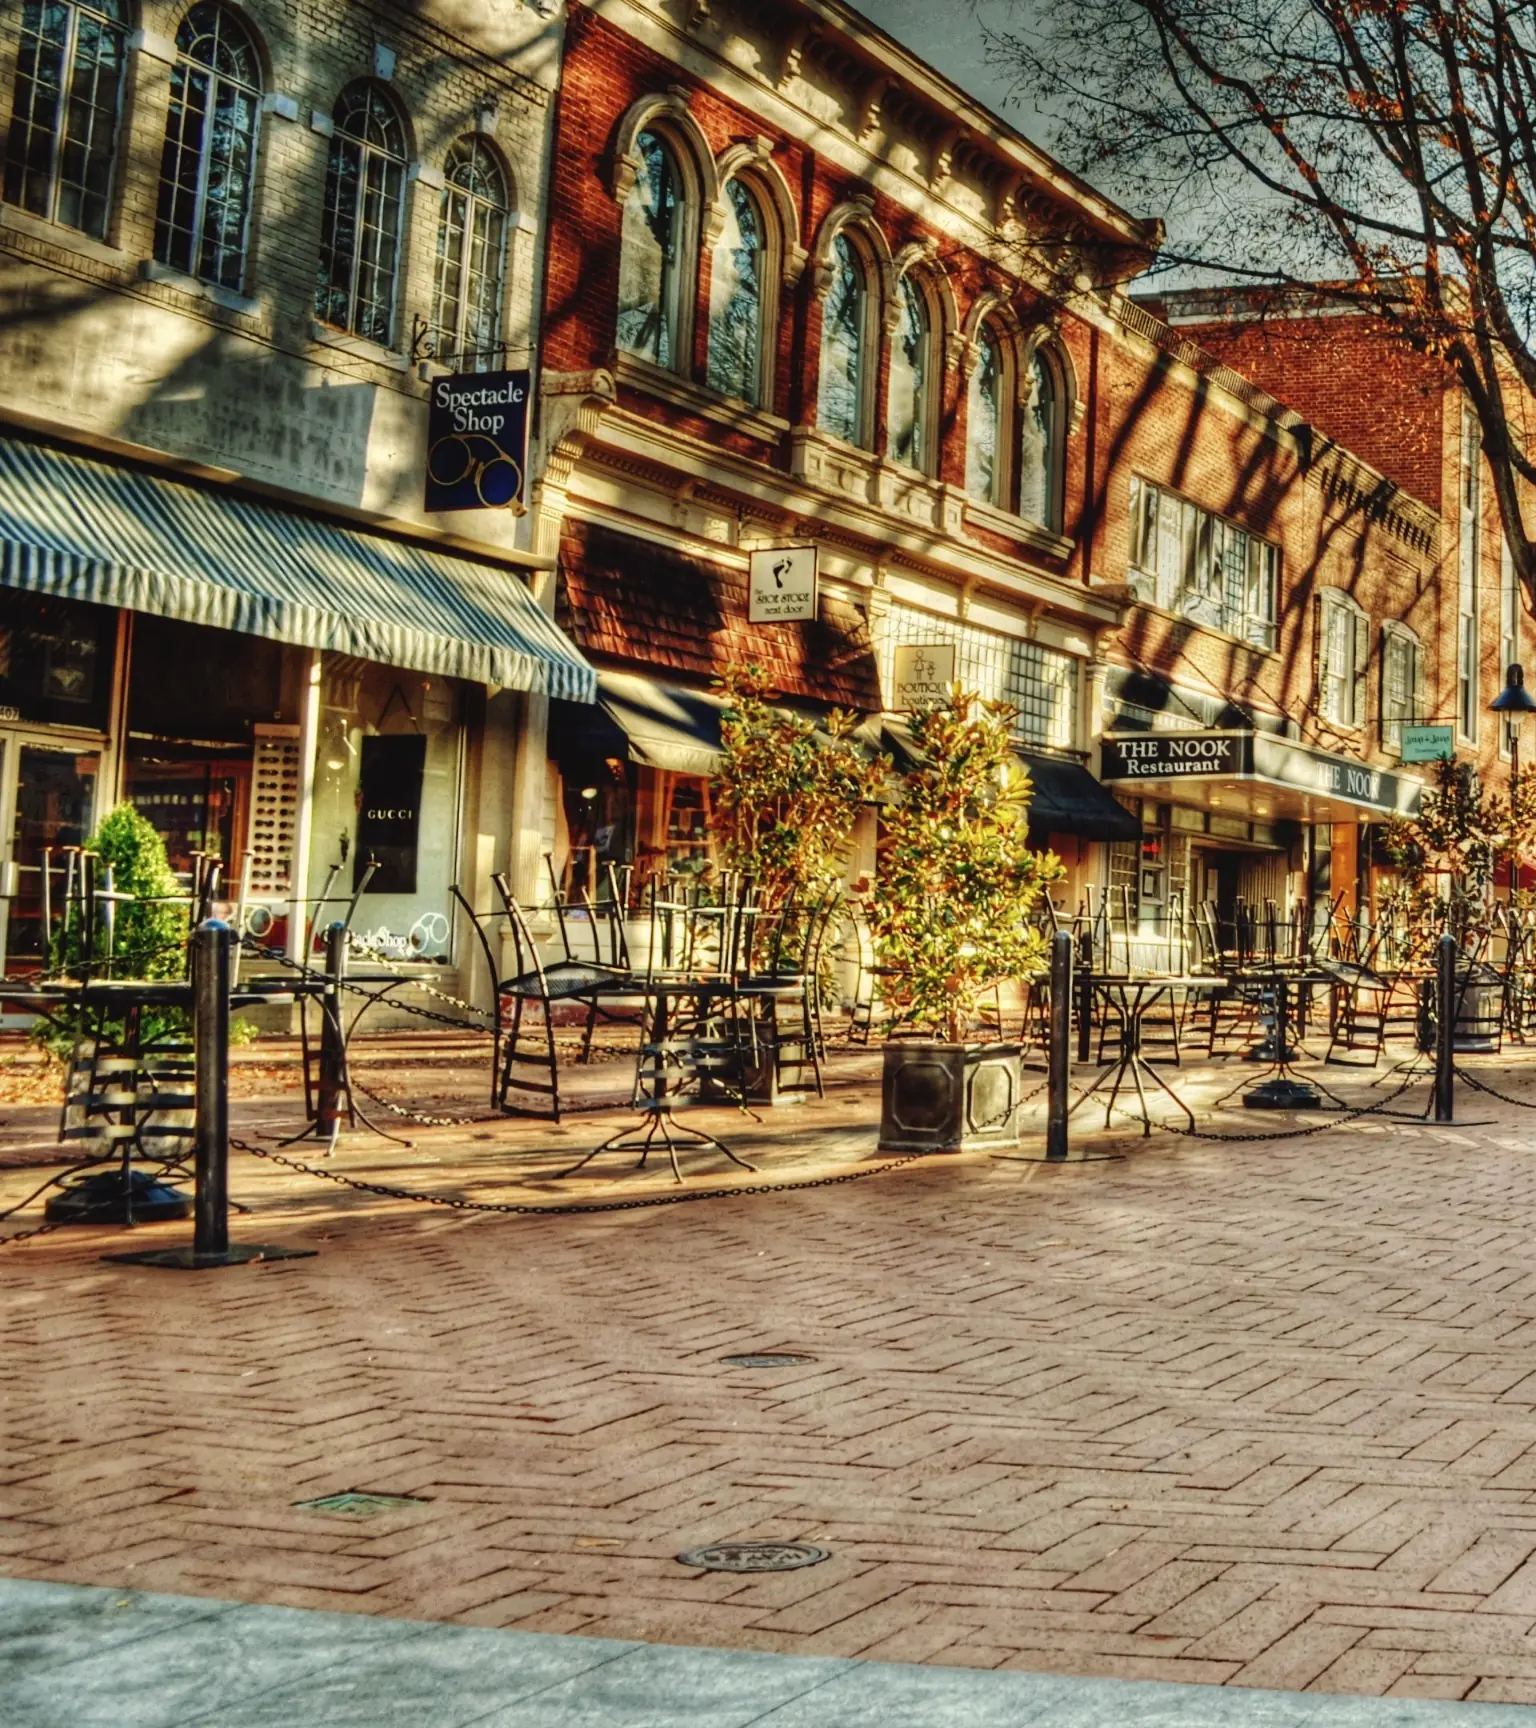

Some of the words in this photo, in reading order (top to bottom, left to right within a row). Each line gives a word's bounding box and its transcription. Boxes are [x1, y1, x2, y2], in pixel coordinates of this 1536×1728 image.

[436, 381, 523, 412] Spectacle
[453, 406, 505, 435] Shop
[756, 594, 779, 604] SHOE
[780, 593, 809, 603] STORE
[765, 606, 781, 615] next
[783, 604, 804, 614] door
[897, 682, 948, 694] BOUTIQU
[1117, 741, 1158, 758] THE
[1169, 740, 1231, 757] NOOK
[1127, 758, 1220, 775] Restaurant
[1317, 762, 1341, 790] THE
[1347, 769, 1379, 800] NOOK
[367, 809, 412, 820] GUCCI
